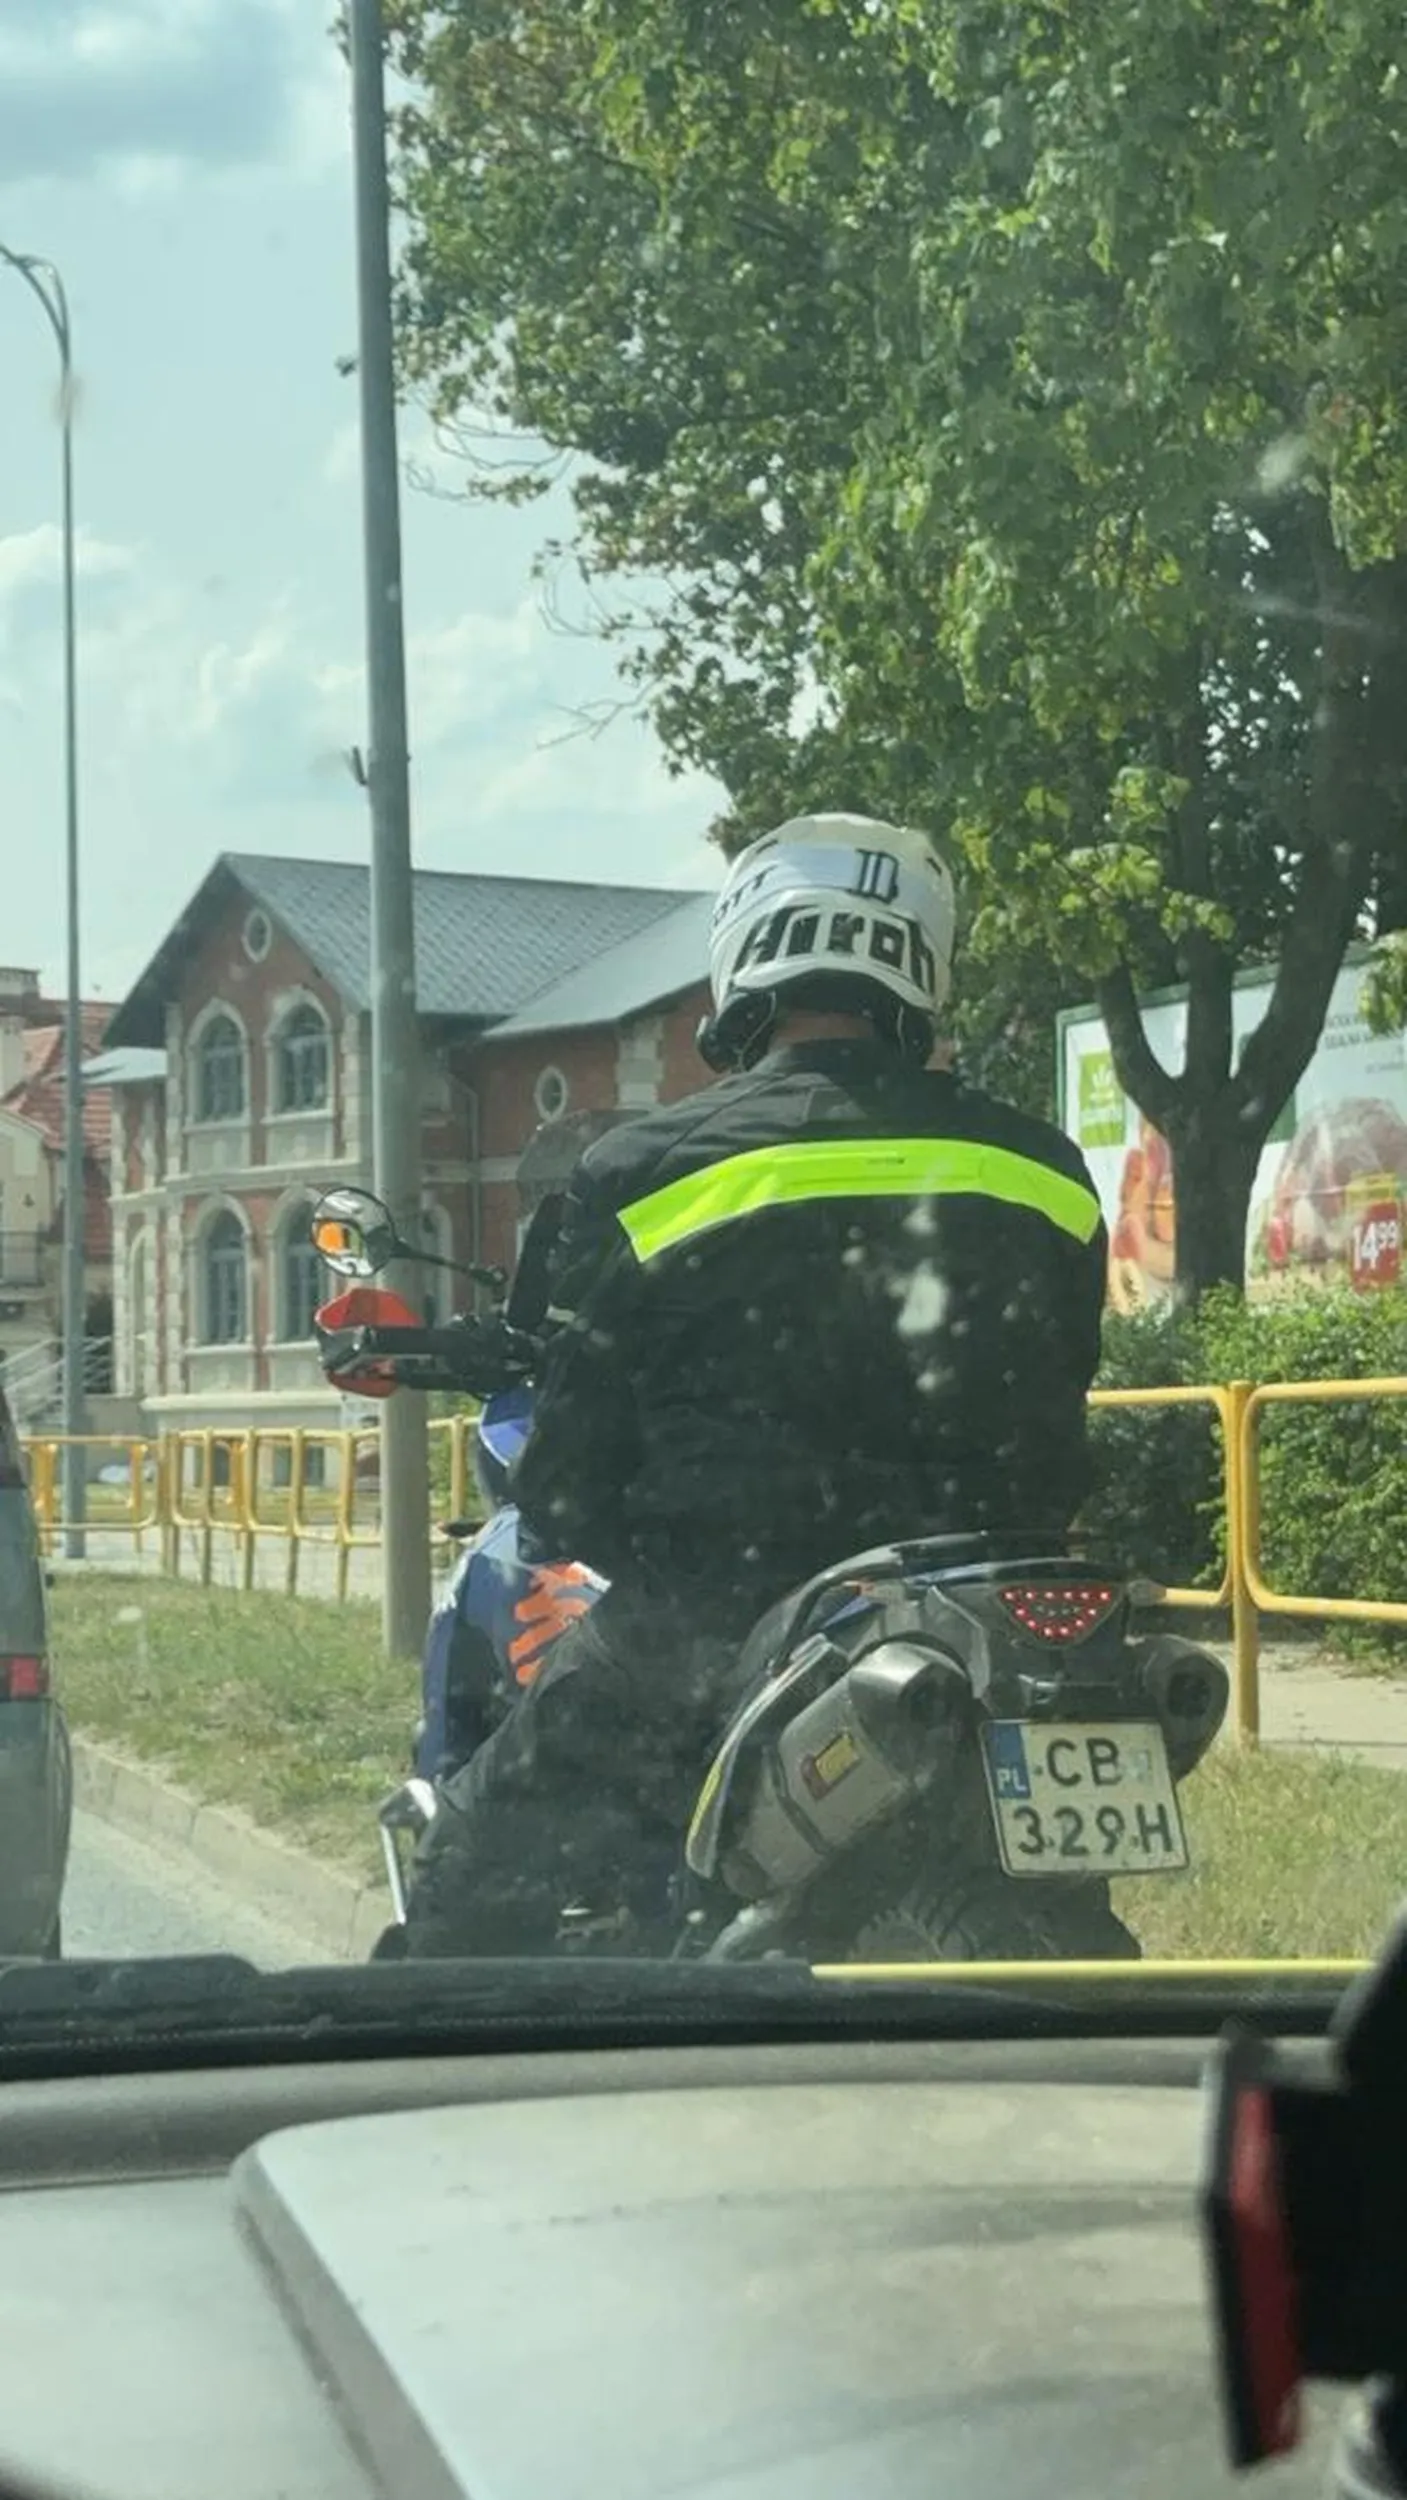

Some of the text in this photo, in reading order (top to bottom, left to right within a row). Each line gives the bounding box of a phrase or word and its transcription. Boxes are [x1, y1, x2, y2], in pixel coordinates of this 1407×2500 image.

[997, 1767, 1028, 1792] PL
[1046, 1737, 1123, 1786] CB
[1013, 1803, 1173, 1857] 329H
